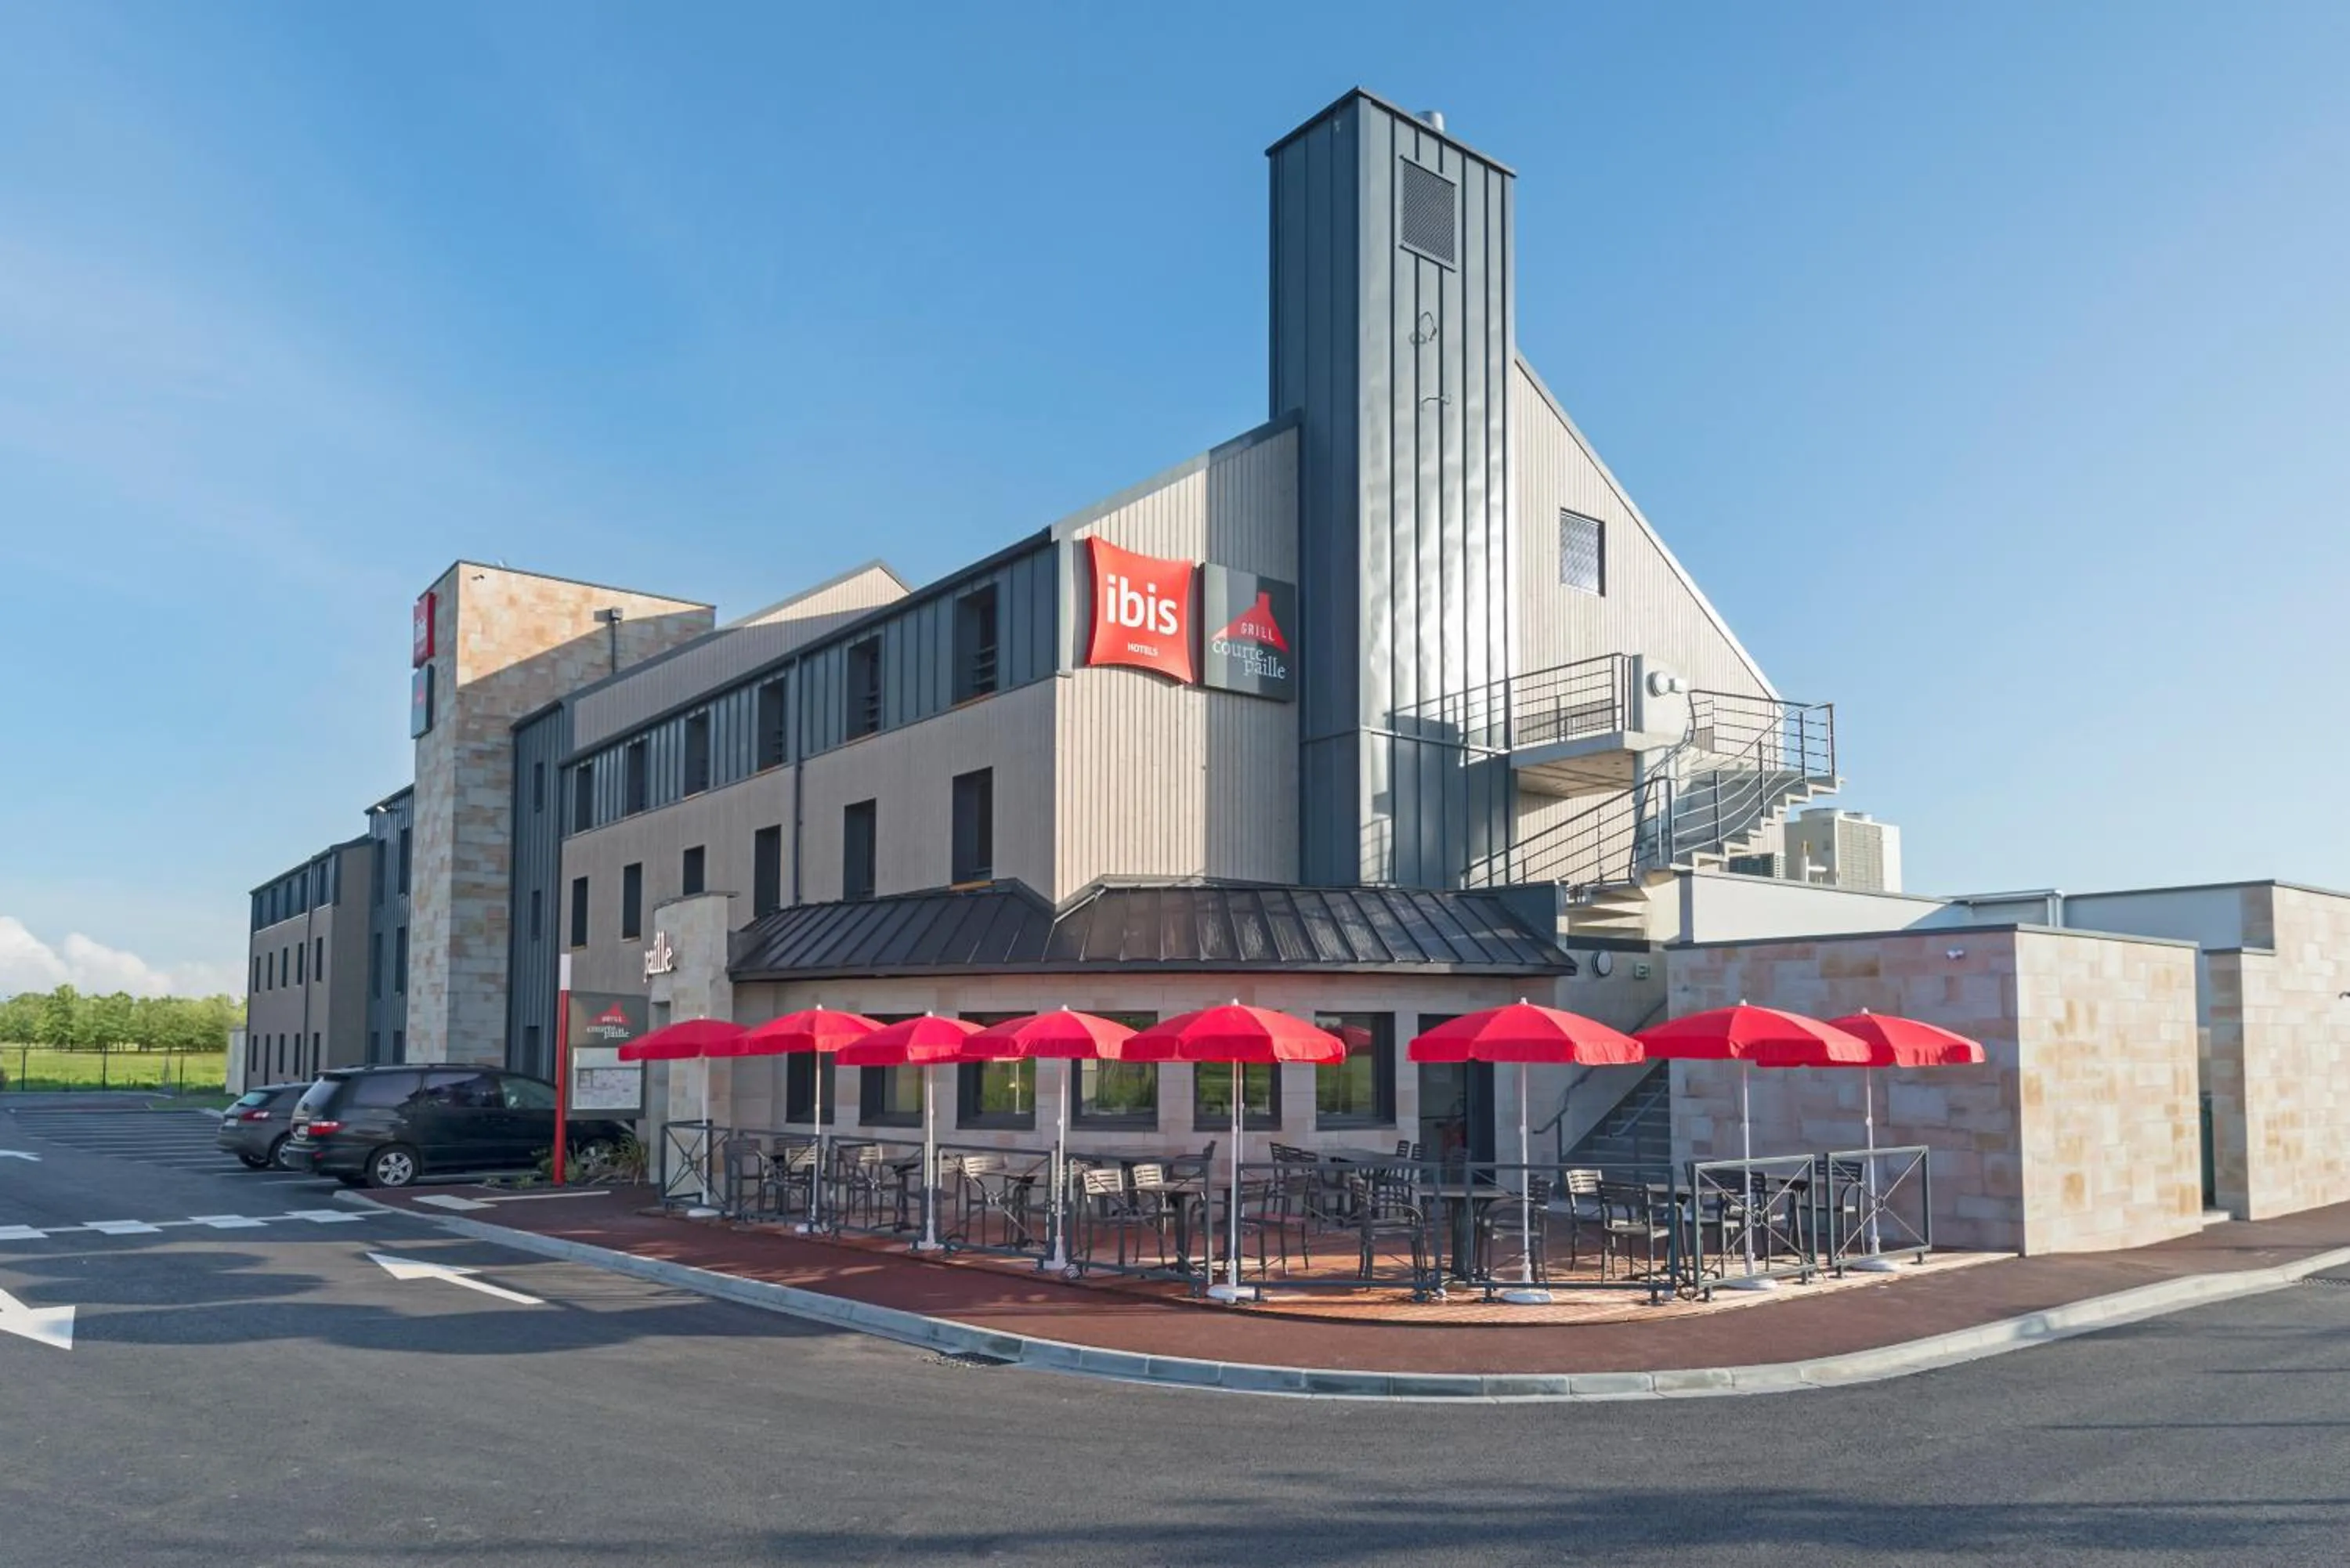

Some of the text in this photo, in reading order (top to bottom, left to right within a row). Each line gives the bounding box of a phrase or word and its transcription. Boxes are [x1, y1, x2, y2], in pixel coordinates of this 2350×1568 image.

[1106, 573, 1178, 636] ibis
[1240, 622, 1275, 641] GRILL
[1127, 642, 1159, 656] HOTELS
[1212, 639, 1264, 662] courte
[1243, 656, 1285, 679] paille
